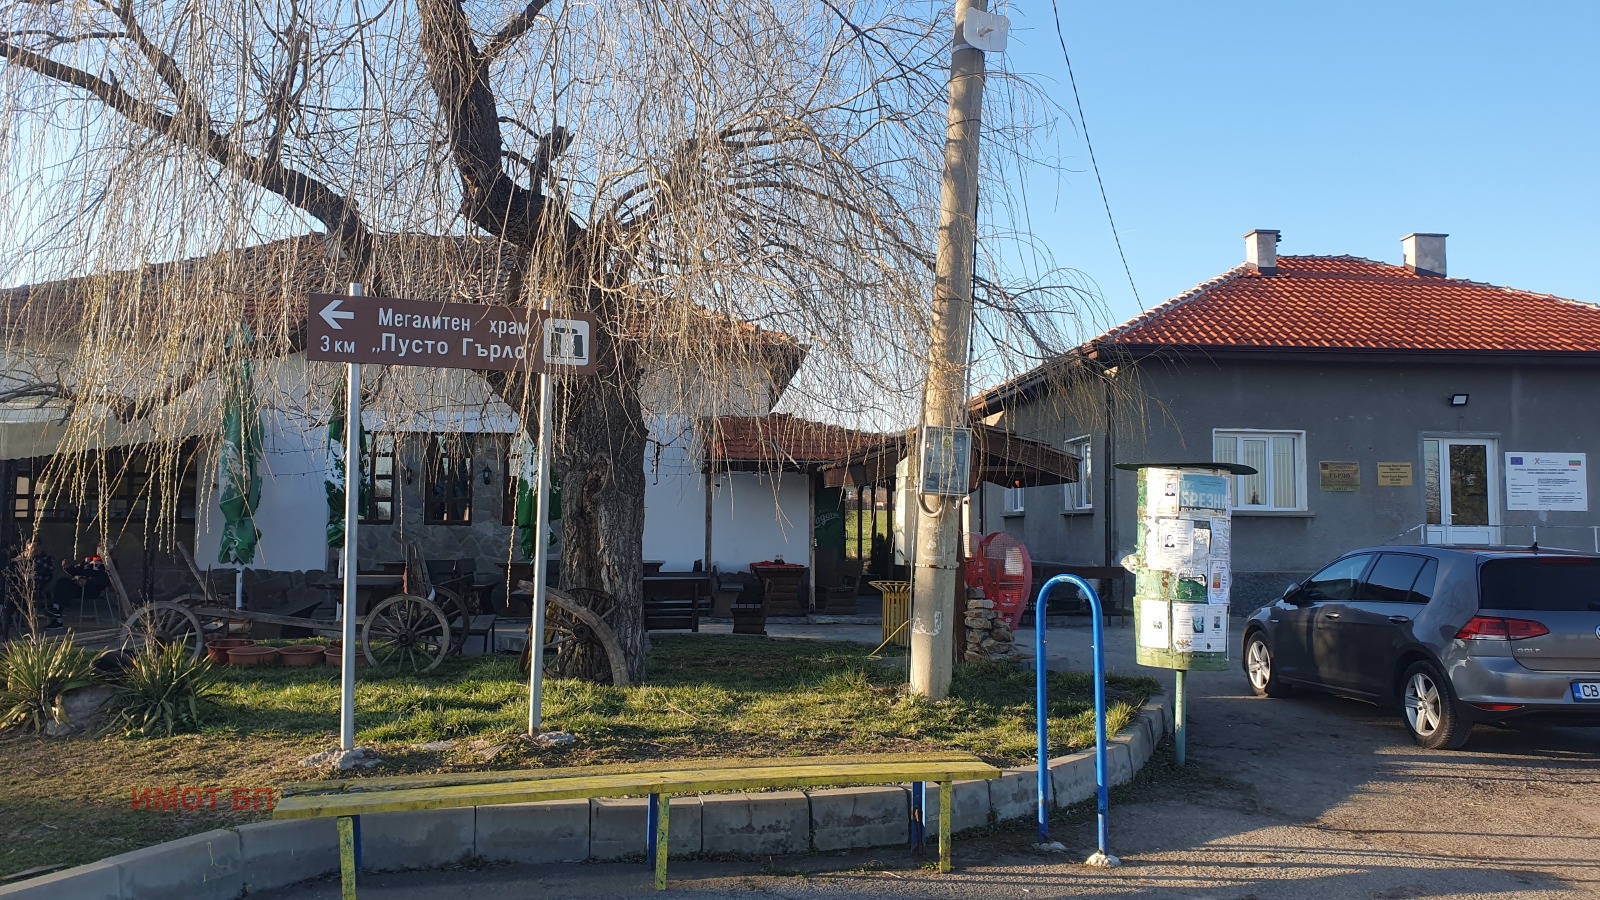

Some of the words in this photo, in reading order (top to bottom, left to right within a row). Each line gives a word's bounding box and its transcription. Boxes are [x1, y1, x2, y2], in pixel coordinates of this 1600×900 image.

[378, 307, 471, 331] Мегалитен
[489, 319, 529, 338] храм
[320, 335, 330, 352] 3
[334, 340, 355, 354] км
